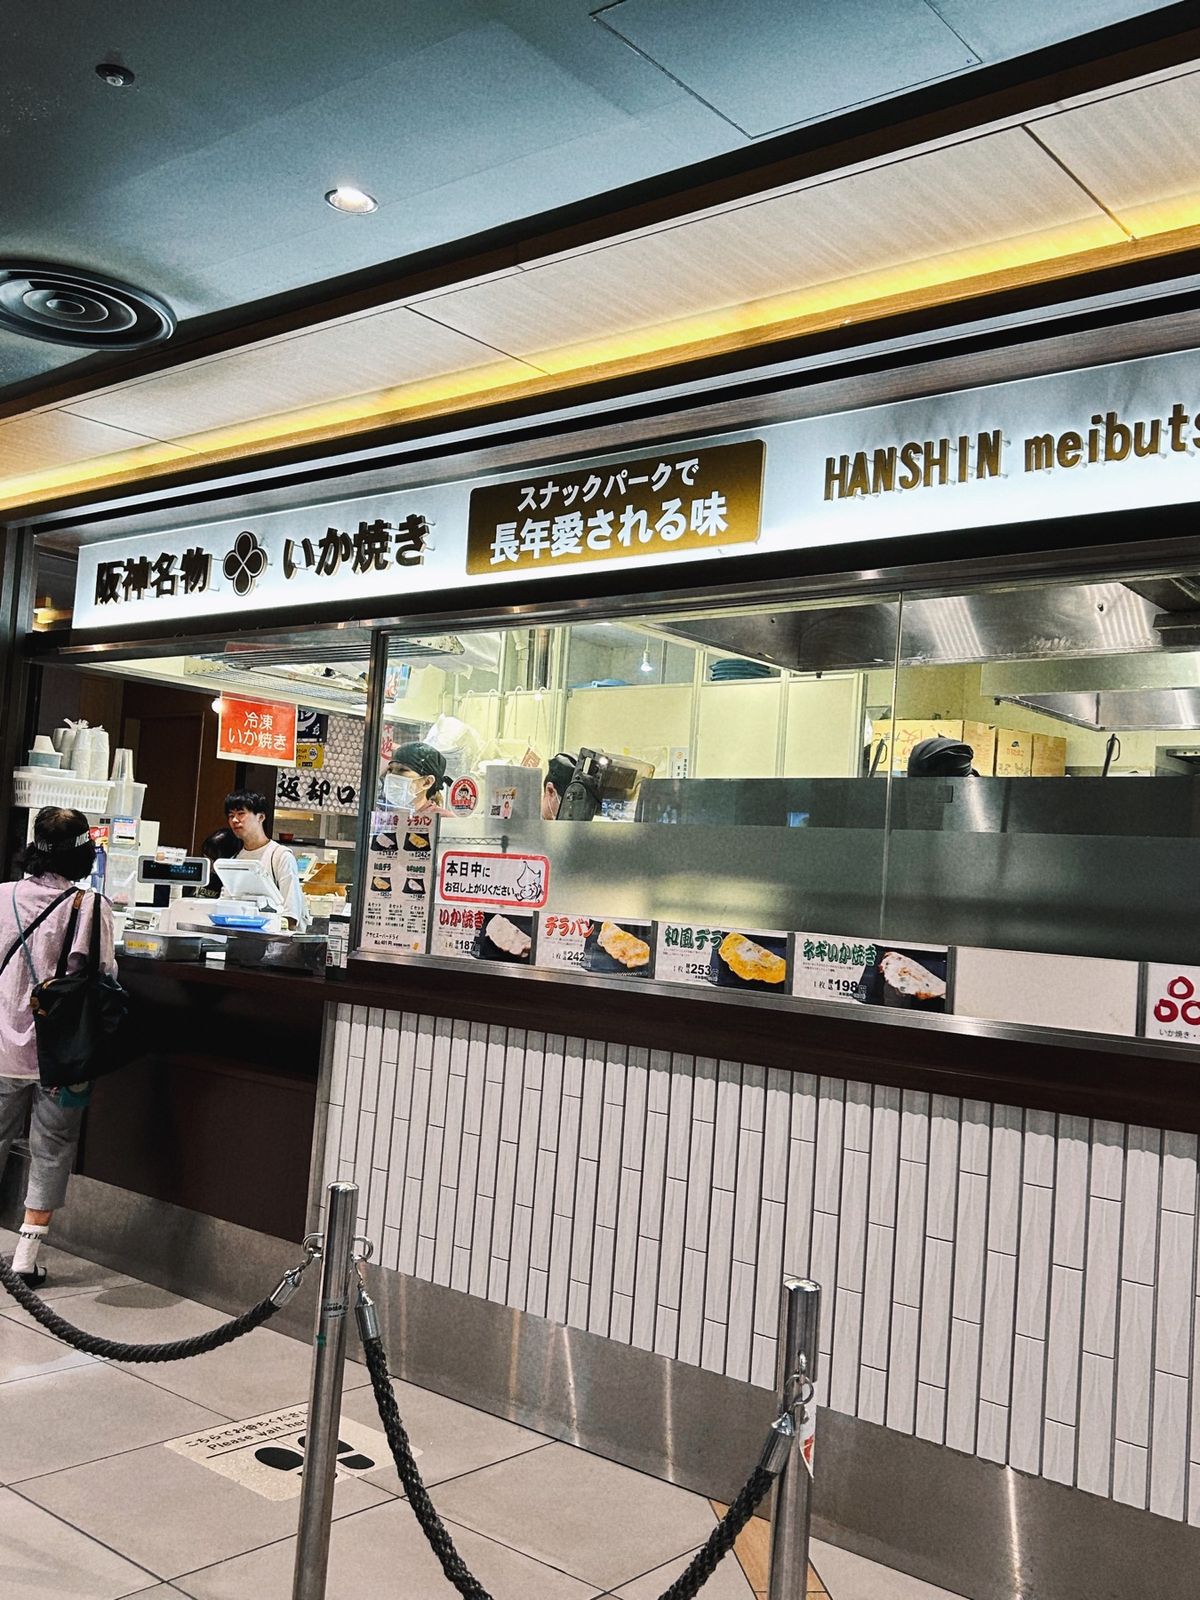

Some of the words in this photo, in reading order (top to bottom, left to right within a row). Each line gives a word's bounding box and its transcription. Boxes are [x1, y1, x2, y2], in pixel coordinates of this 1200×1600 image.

[824, 430, 1002, 501] HANSHIN
[517, 457, 699, 512] スナックパークで
[489, 490, 729, 565] 長年愛される味
[283, 513, 430, 580] いか焼き
[94, 547, 213, 606] 阪神名物
[243, 710, 273, 731] 冷凍
[228, 727, 287, 751] いか焼き
[277, 772, 356, 806] 返却口
[446, 860, 491, 878] 本日中に
[444, 881, 515, 897] お召し上がりください
[439, 908, 484, 928] いか焼き
[460, 940, 476, 951] 187
[664, 925, 723, 951] 和風デラ
[567, 951, 586, 962] 242
[803, 939, 877, 967] ネギいか焼き
[691, 963, 711, 976] 253
[834, 979, 859, 993] 198
[207, 1435, 254, 1450] Please
[255, 1426, 285, 1437] wait
